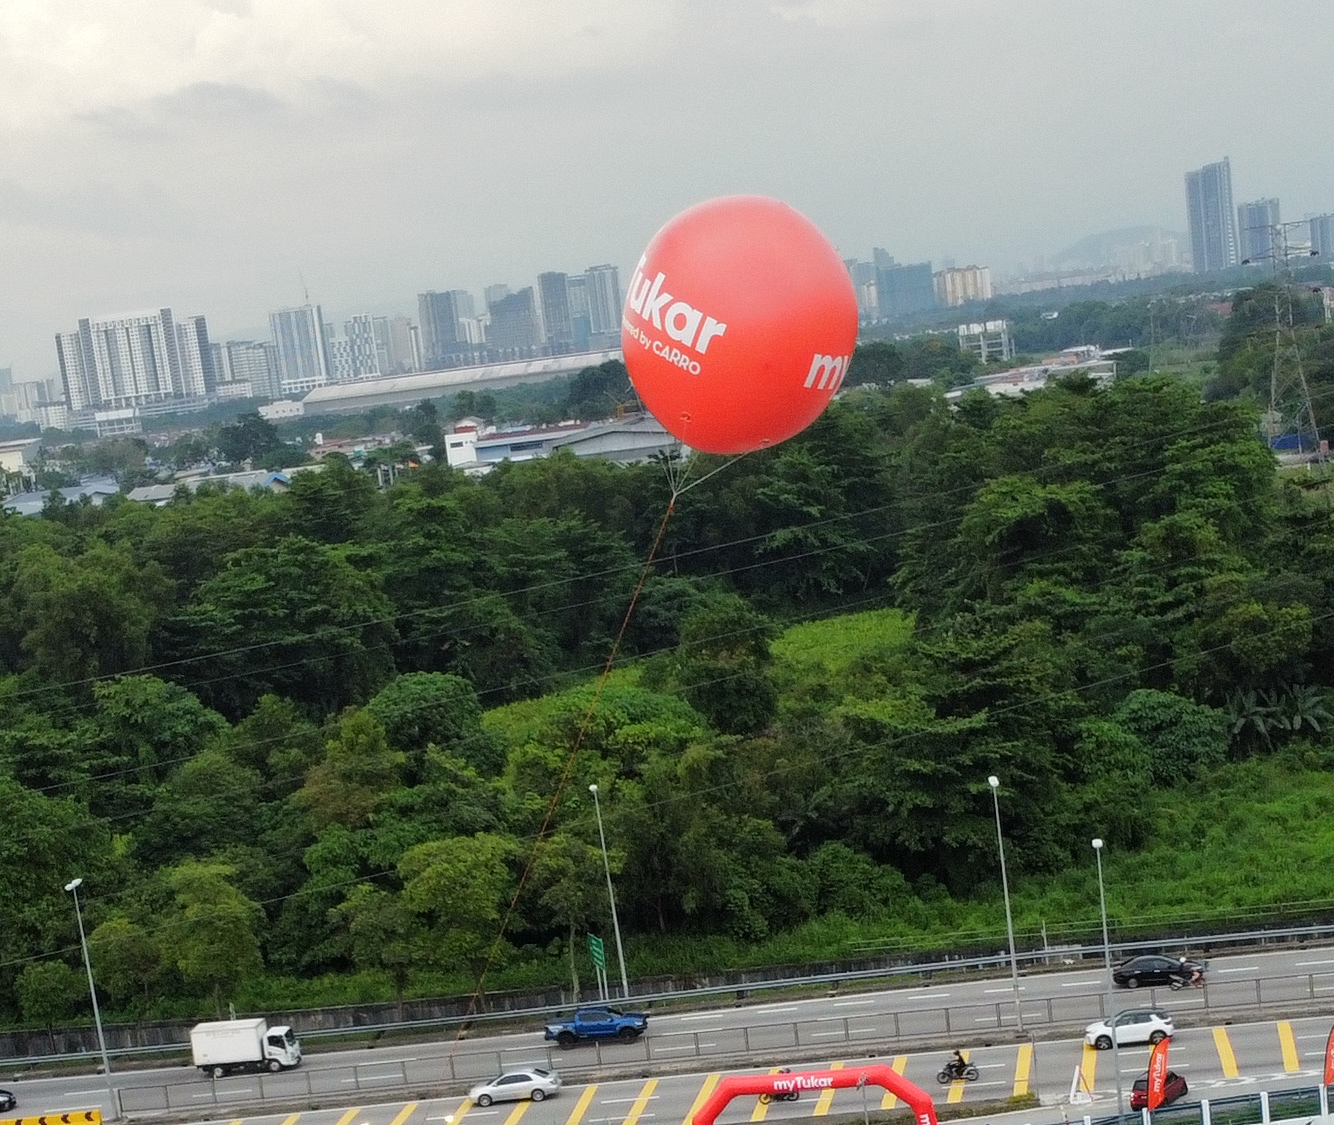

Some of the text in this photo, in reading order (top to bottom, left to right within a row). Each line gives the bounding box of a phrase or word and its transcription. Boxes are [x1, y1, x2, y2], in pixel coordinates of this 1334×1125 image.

[627, 268, 727, 355] ukar
[652, 340, 702, 376] CARRO
[773, 1075, 834, 1091] myTukar
